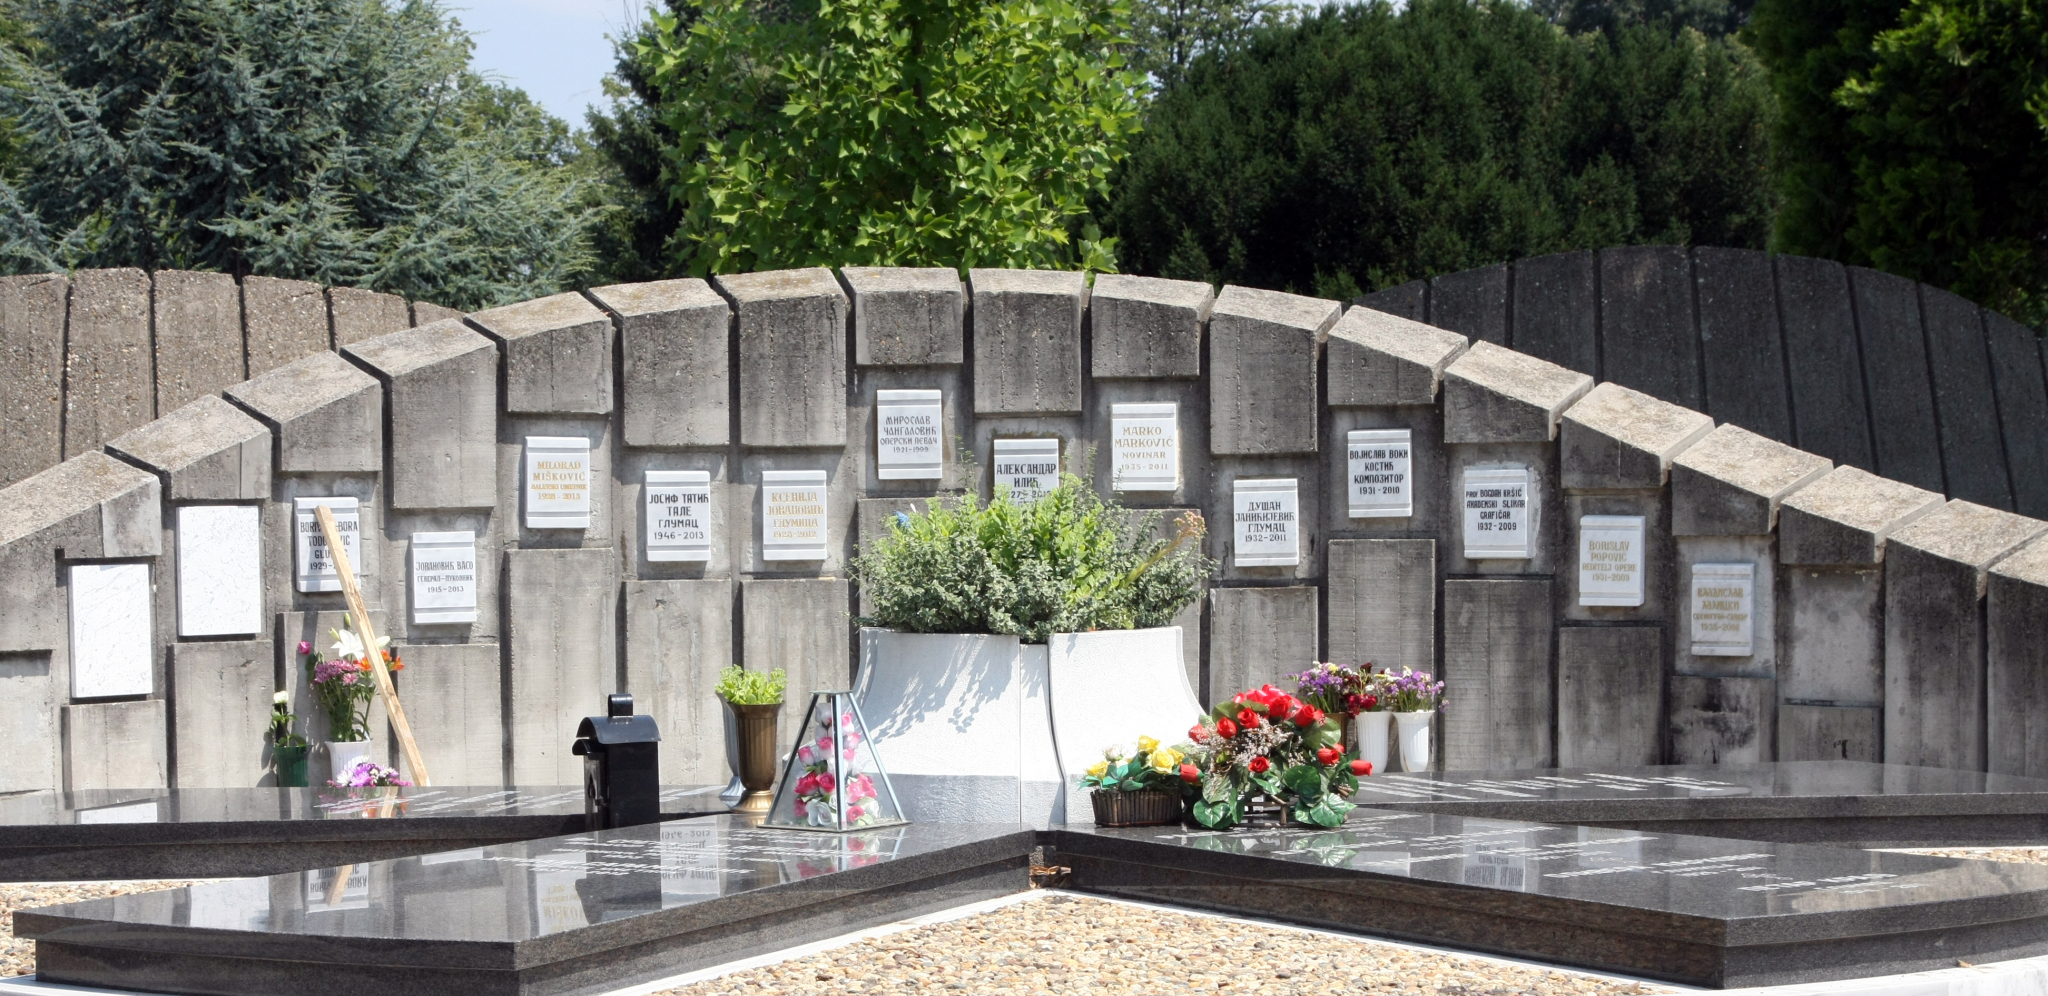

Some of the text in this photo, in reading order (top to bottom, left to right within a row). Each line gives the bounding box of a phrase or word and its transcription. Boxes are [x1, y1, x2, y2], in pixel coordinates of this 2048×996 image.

[885, 415, 931, 425] МИРОСЛАВ
[883, 426, 937, 436] ЧАНГАЛОВИЋ
[1122, 426, 1162, 436] MARKO
[880, 436, 938, 446] ОПЕРСКИ ПЕВАЧ
[1114, 435, 1174, 448] MARKOVIĆ
[1122, 451, 1166, 459] NOVINAR
[1349, 449, 1408, 460] ВОЈИСЛАВ ВОКИ
[537, 461, 581, 470] MILORAD
[996, 463, 1057, 475] АЛЕКСАНДАР
[1364, 461, 1394, 472] КОСТИЋ
[1013, 476, 1039, 488] ИЛИЋ
[1354, 474, 1404, 484] КОМПОЗИТОР
[648, 493, 709, 504] ЈОСИФ ТАТИЋ
[771, 492, 818, 503] КСЕНИЈА
[1248, 501, 1281, 512] ДУШАН
[1502, 499, 1526, 508] SLIKAR
[667, 506, 692, 517] ТАЛЕ
[766, 505, 824, 516] ЈОВАНОВИЋ
[1479, 509, 1511, 520] GRAFIČAR
[1235, 512, 1295, 522] ЈАНИЋИЈЕВИЋ
[658, 518, 699, 529] ГЛУМАЦ
[773, 518, 819, 528] ГЛУМИЦА
[1248, 523, 1286, 533] ГЛУМАЦ
[1589, 541, 1630, 551] BORISLAV
[415, 560, 474, 572] ЈОВАНОВИЋ ВАСО
[1614, 563, 1637, 572] OPERE
[1697, 587, 1744, 598] ВЛАДИСЛАВ
